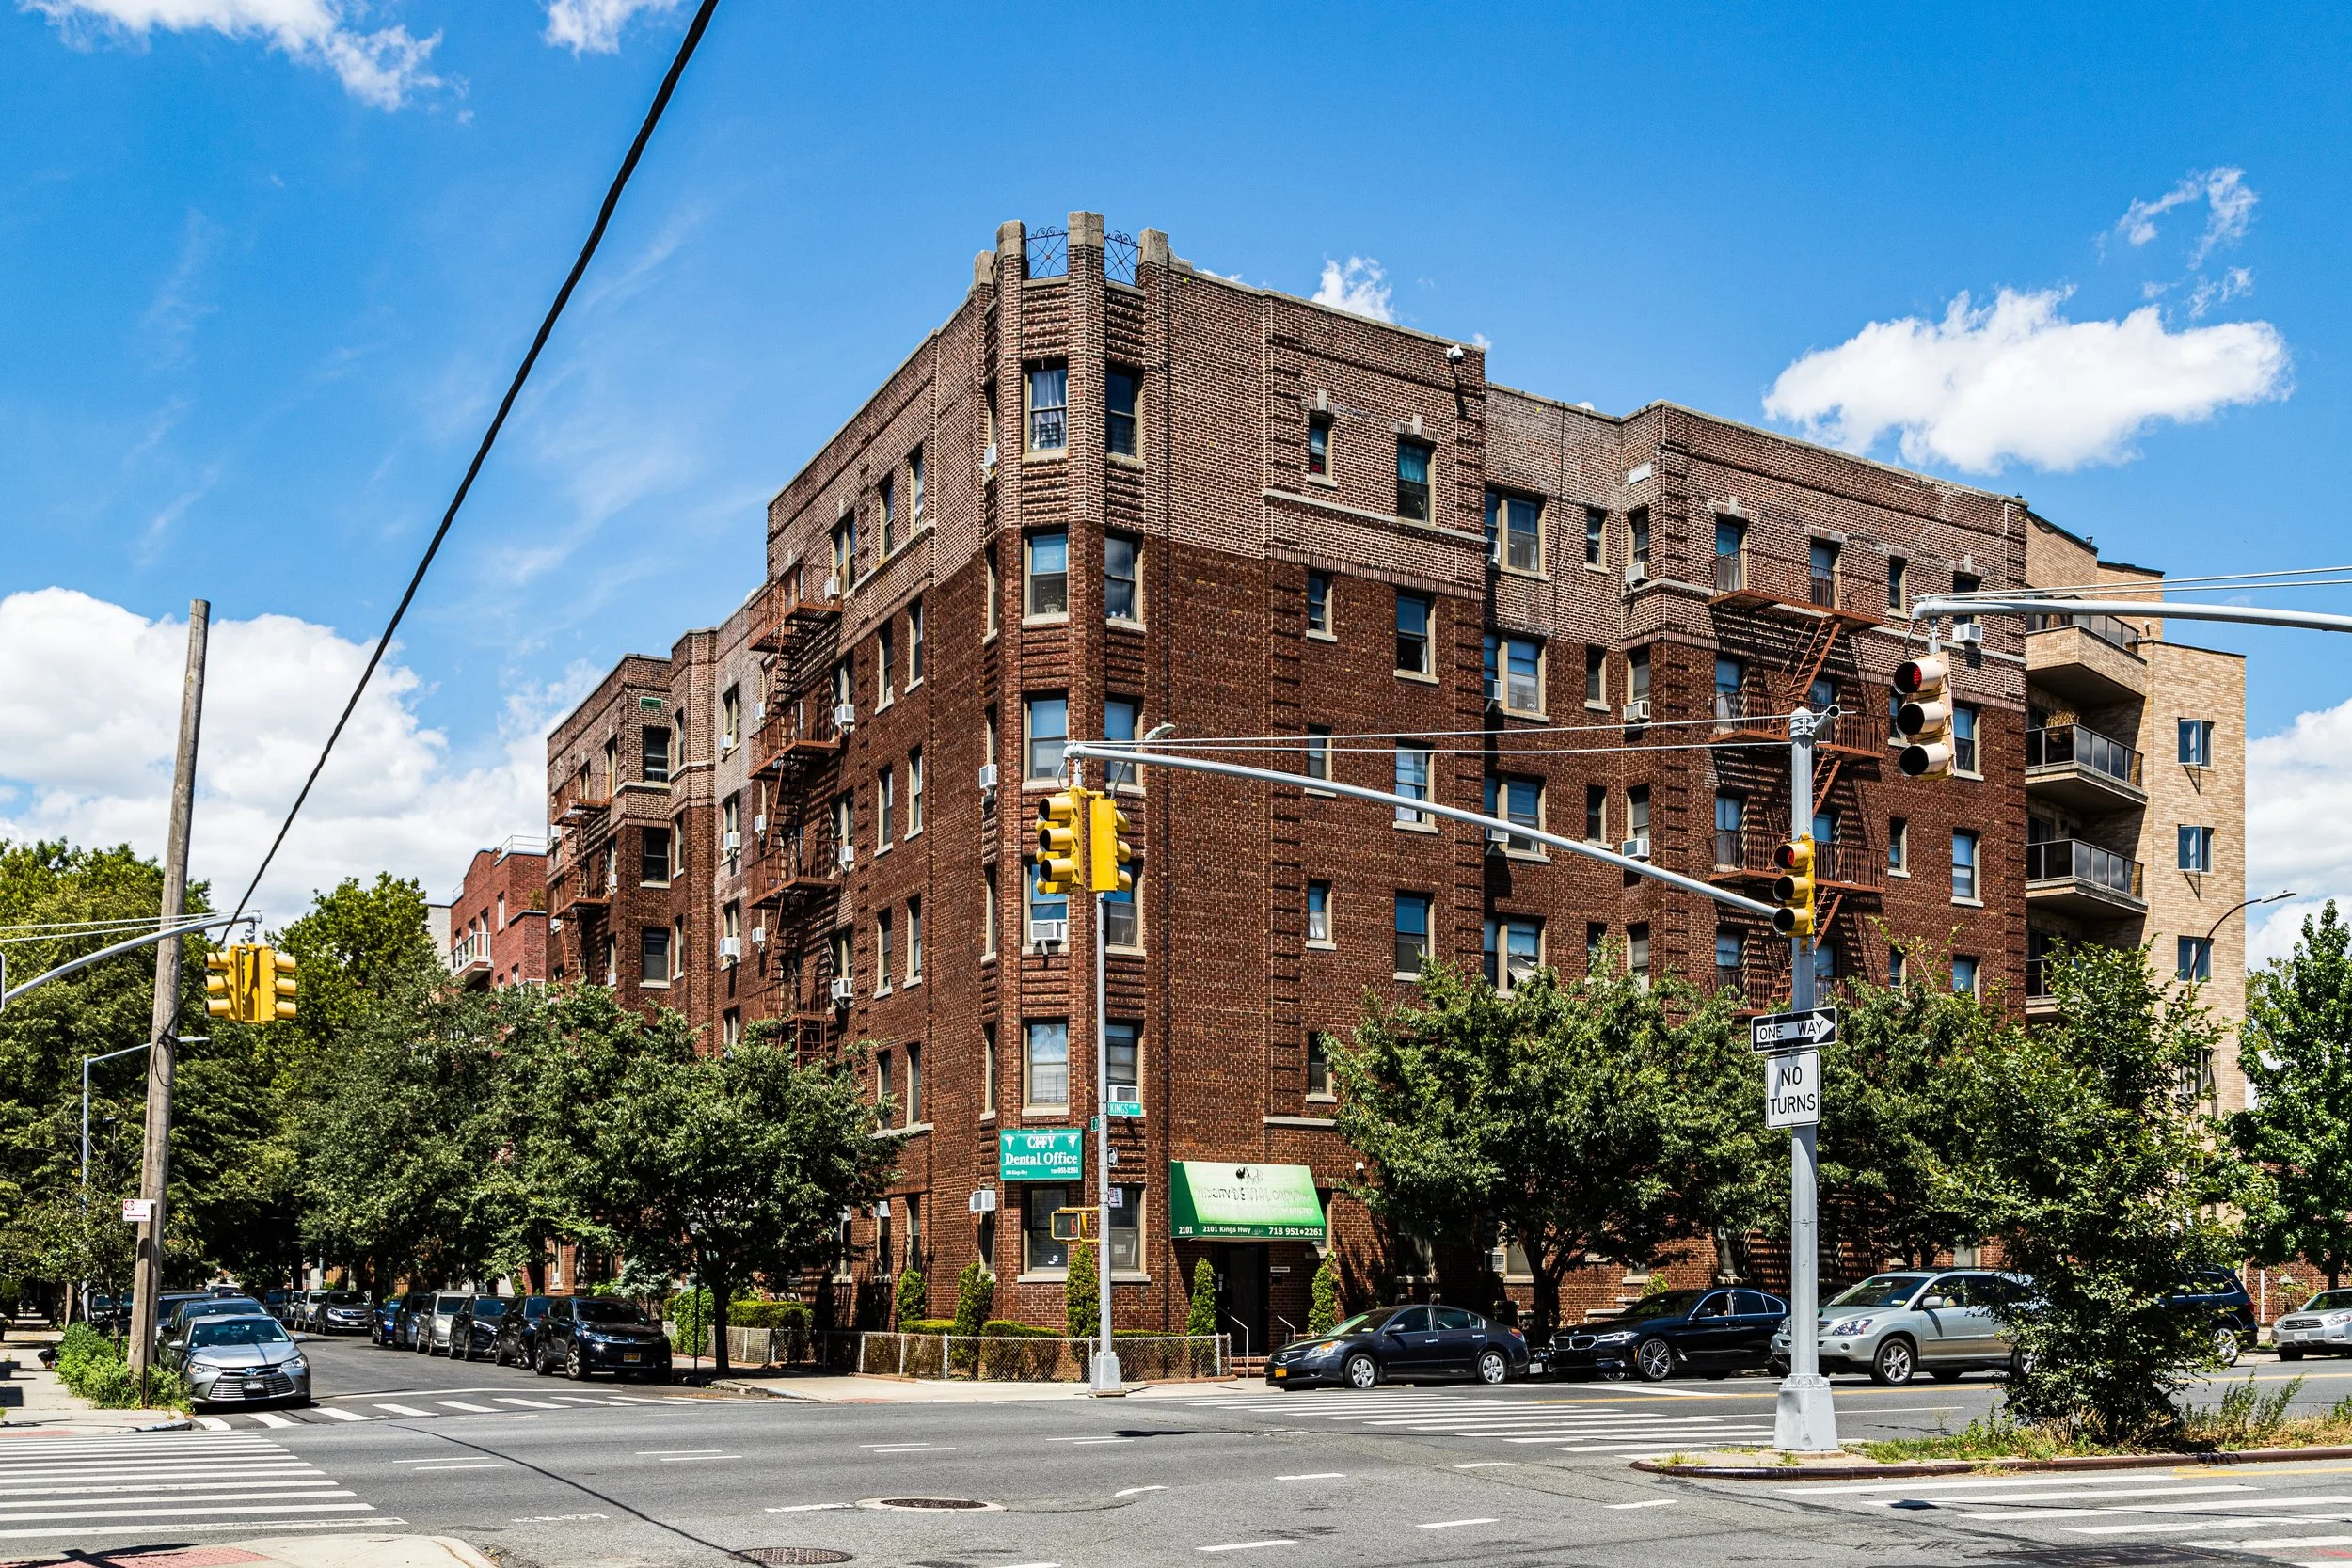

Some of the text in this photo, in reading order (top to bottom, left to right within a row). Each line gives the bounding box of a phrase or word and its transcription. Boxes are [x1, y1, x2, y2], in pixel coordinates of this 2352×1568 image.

[1759, 1020, 1824, 1040] ONE WAY
[1781, 1066, 1803, 1086] NO
[1110, 1103, 1129, 1115] KINGS
[1770, 1093, 1816, 1116] TURNS
[1027, 1135, 1056, 1148] CITY
[1005, 1151, 1078, 1165] Dental Office
[1178, 1226, 1193, 1234] 2101
[1219, 1226, 1237, 1234] Kings
[1237, 1226, 1251, 1234] Hwy
[1268, 1227, 1283, 1235] 718
